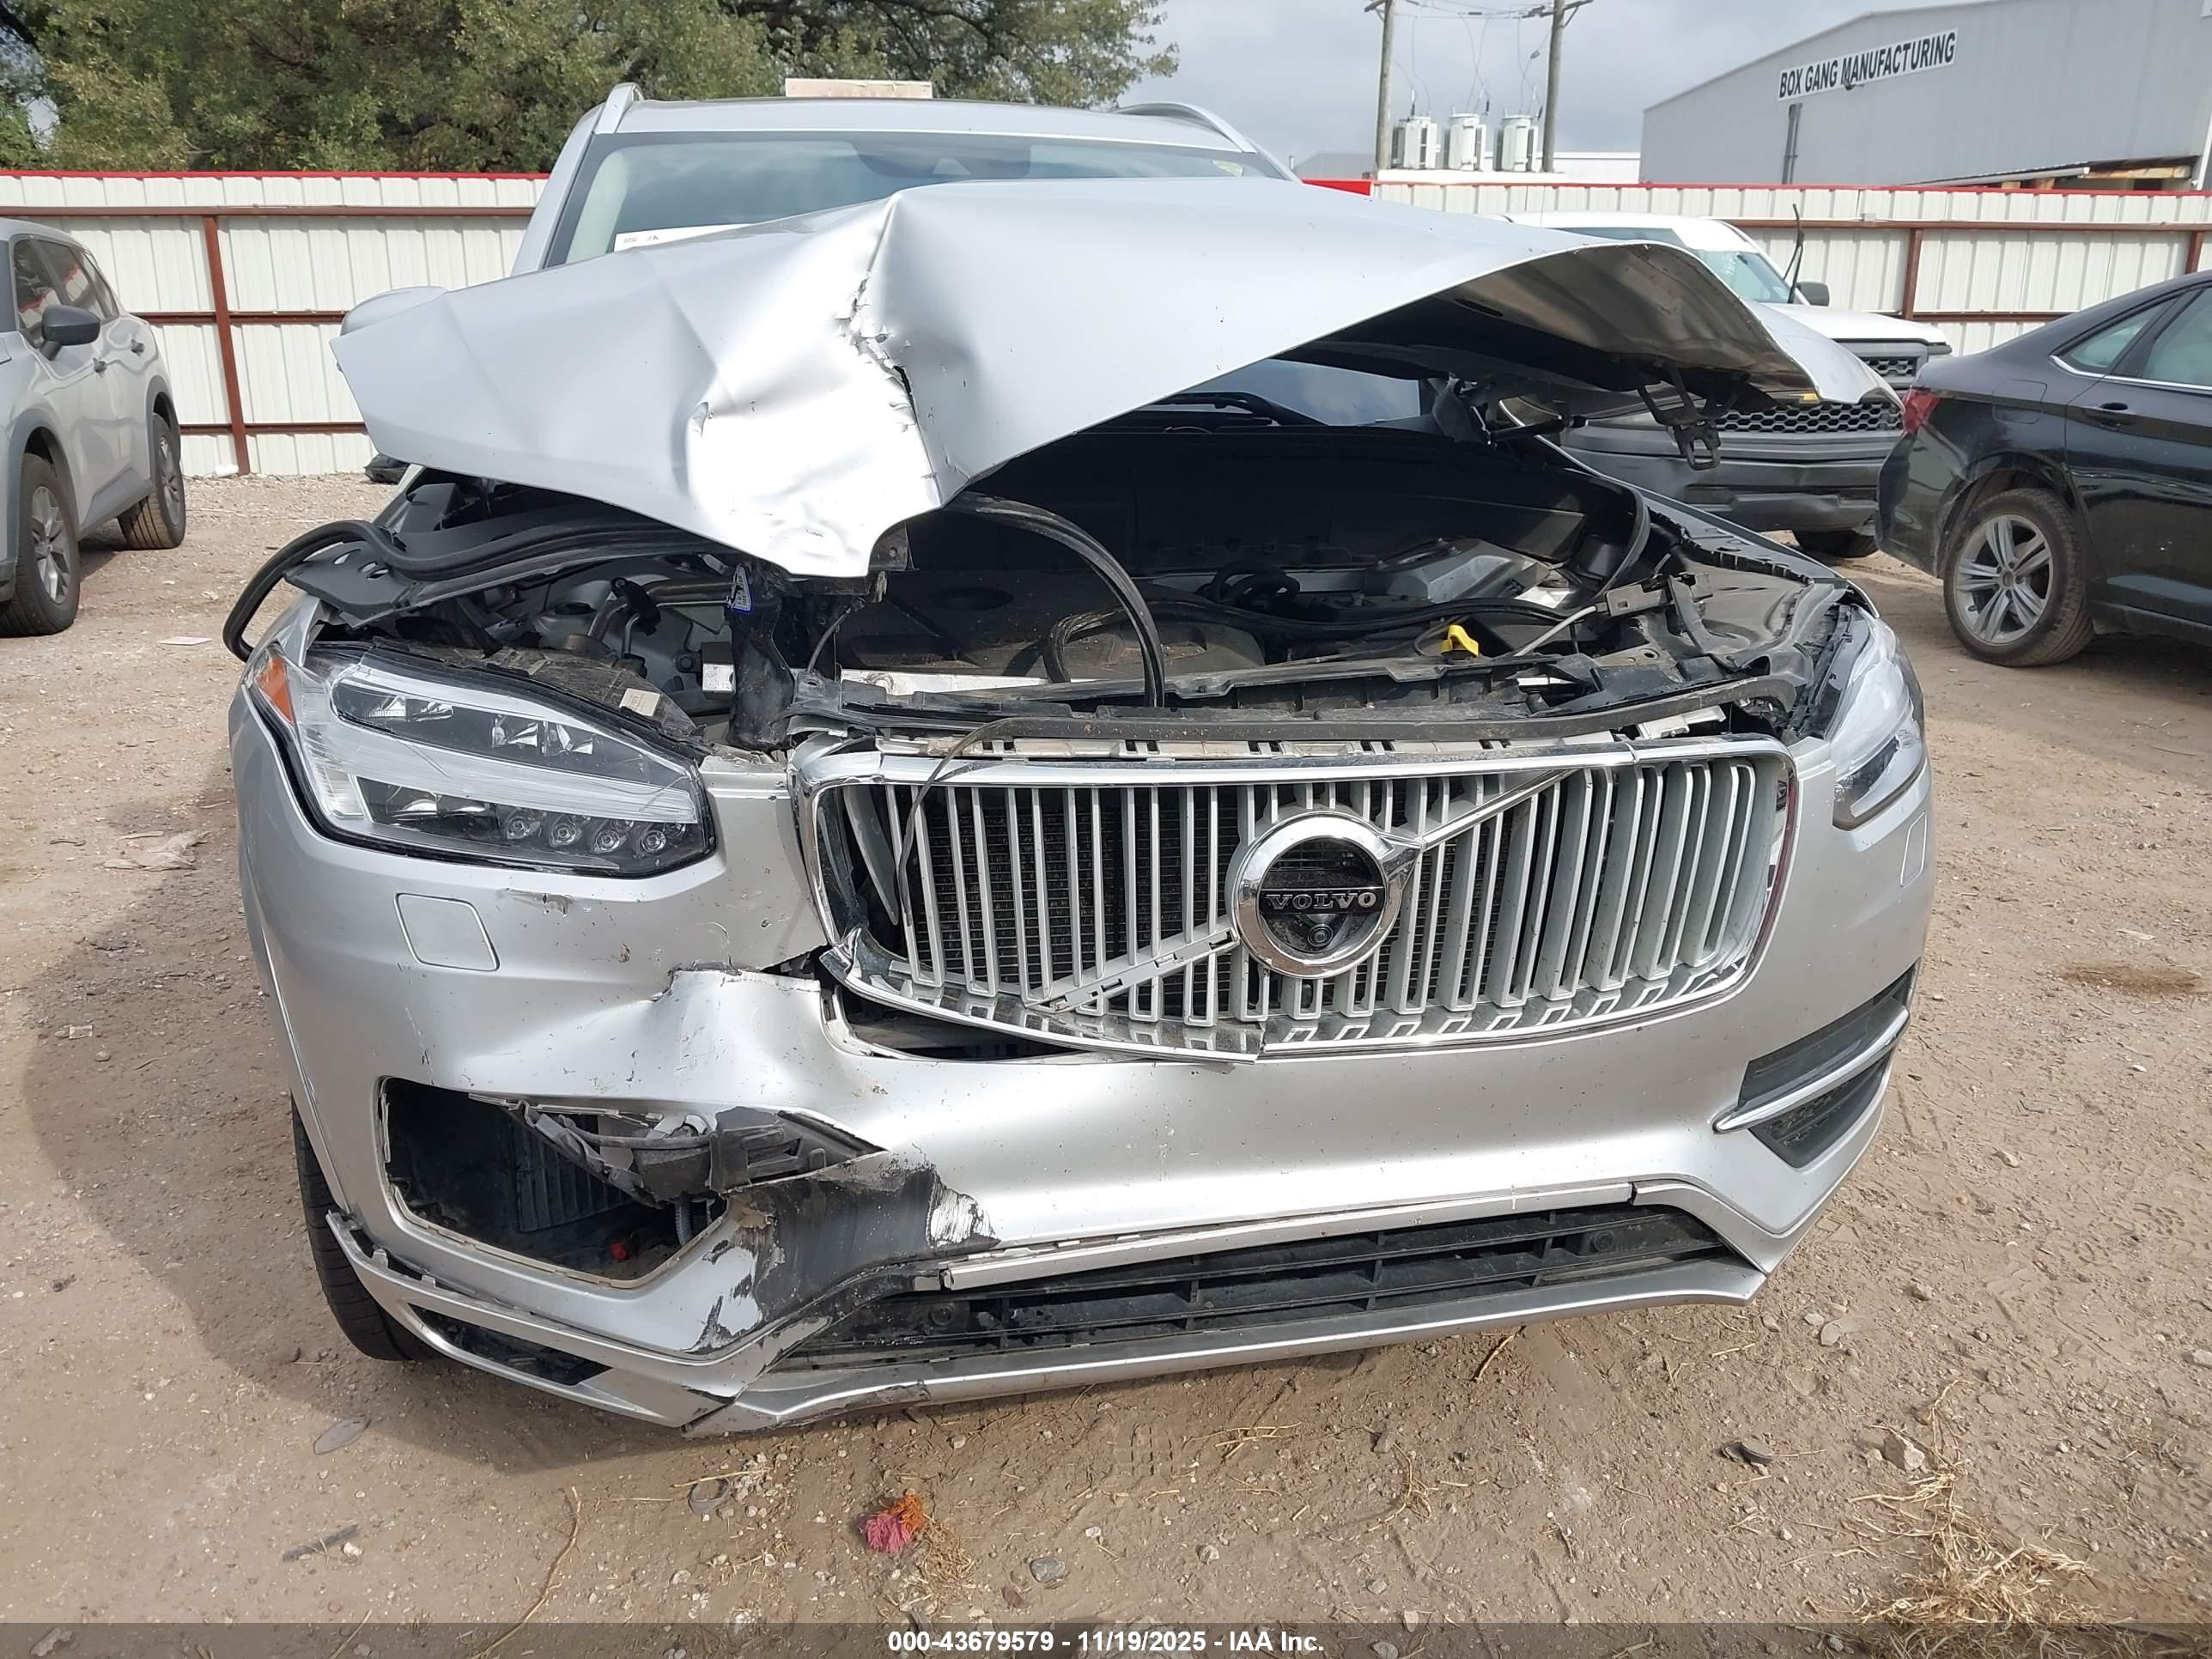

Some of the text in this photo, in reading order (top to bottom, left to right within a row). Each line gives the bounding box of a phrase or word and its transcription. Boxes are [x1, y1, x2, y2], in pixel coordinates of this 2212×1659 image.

[1778, 32, 1956, 99] BOX GANG MANUFACTURING
[1265, 891, 1376, 910] VOLVO
